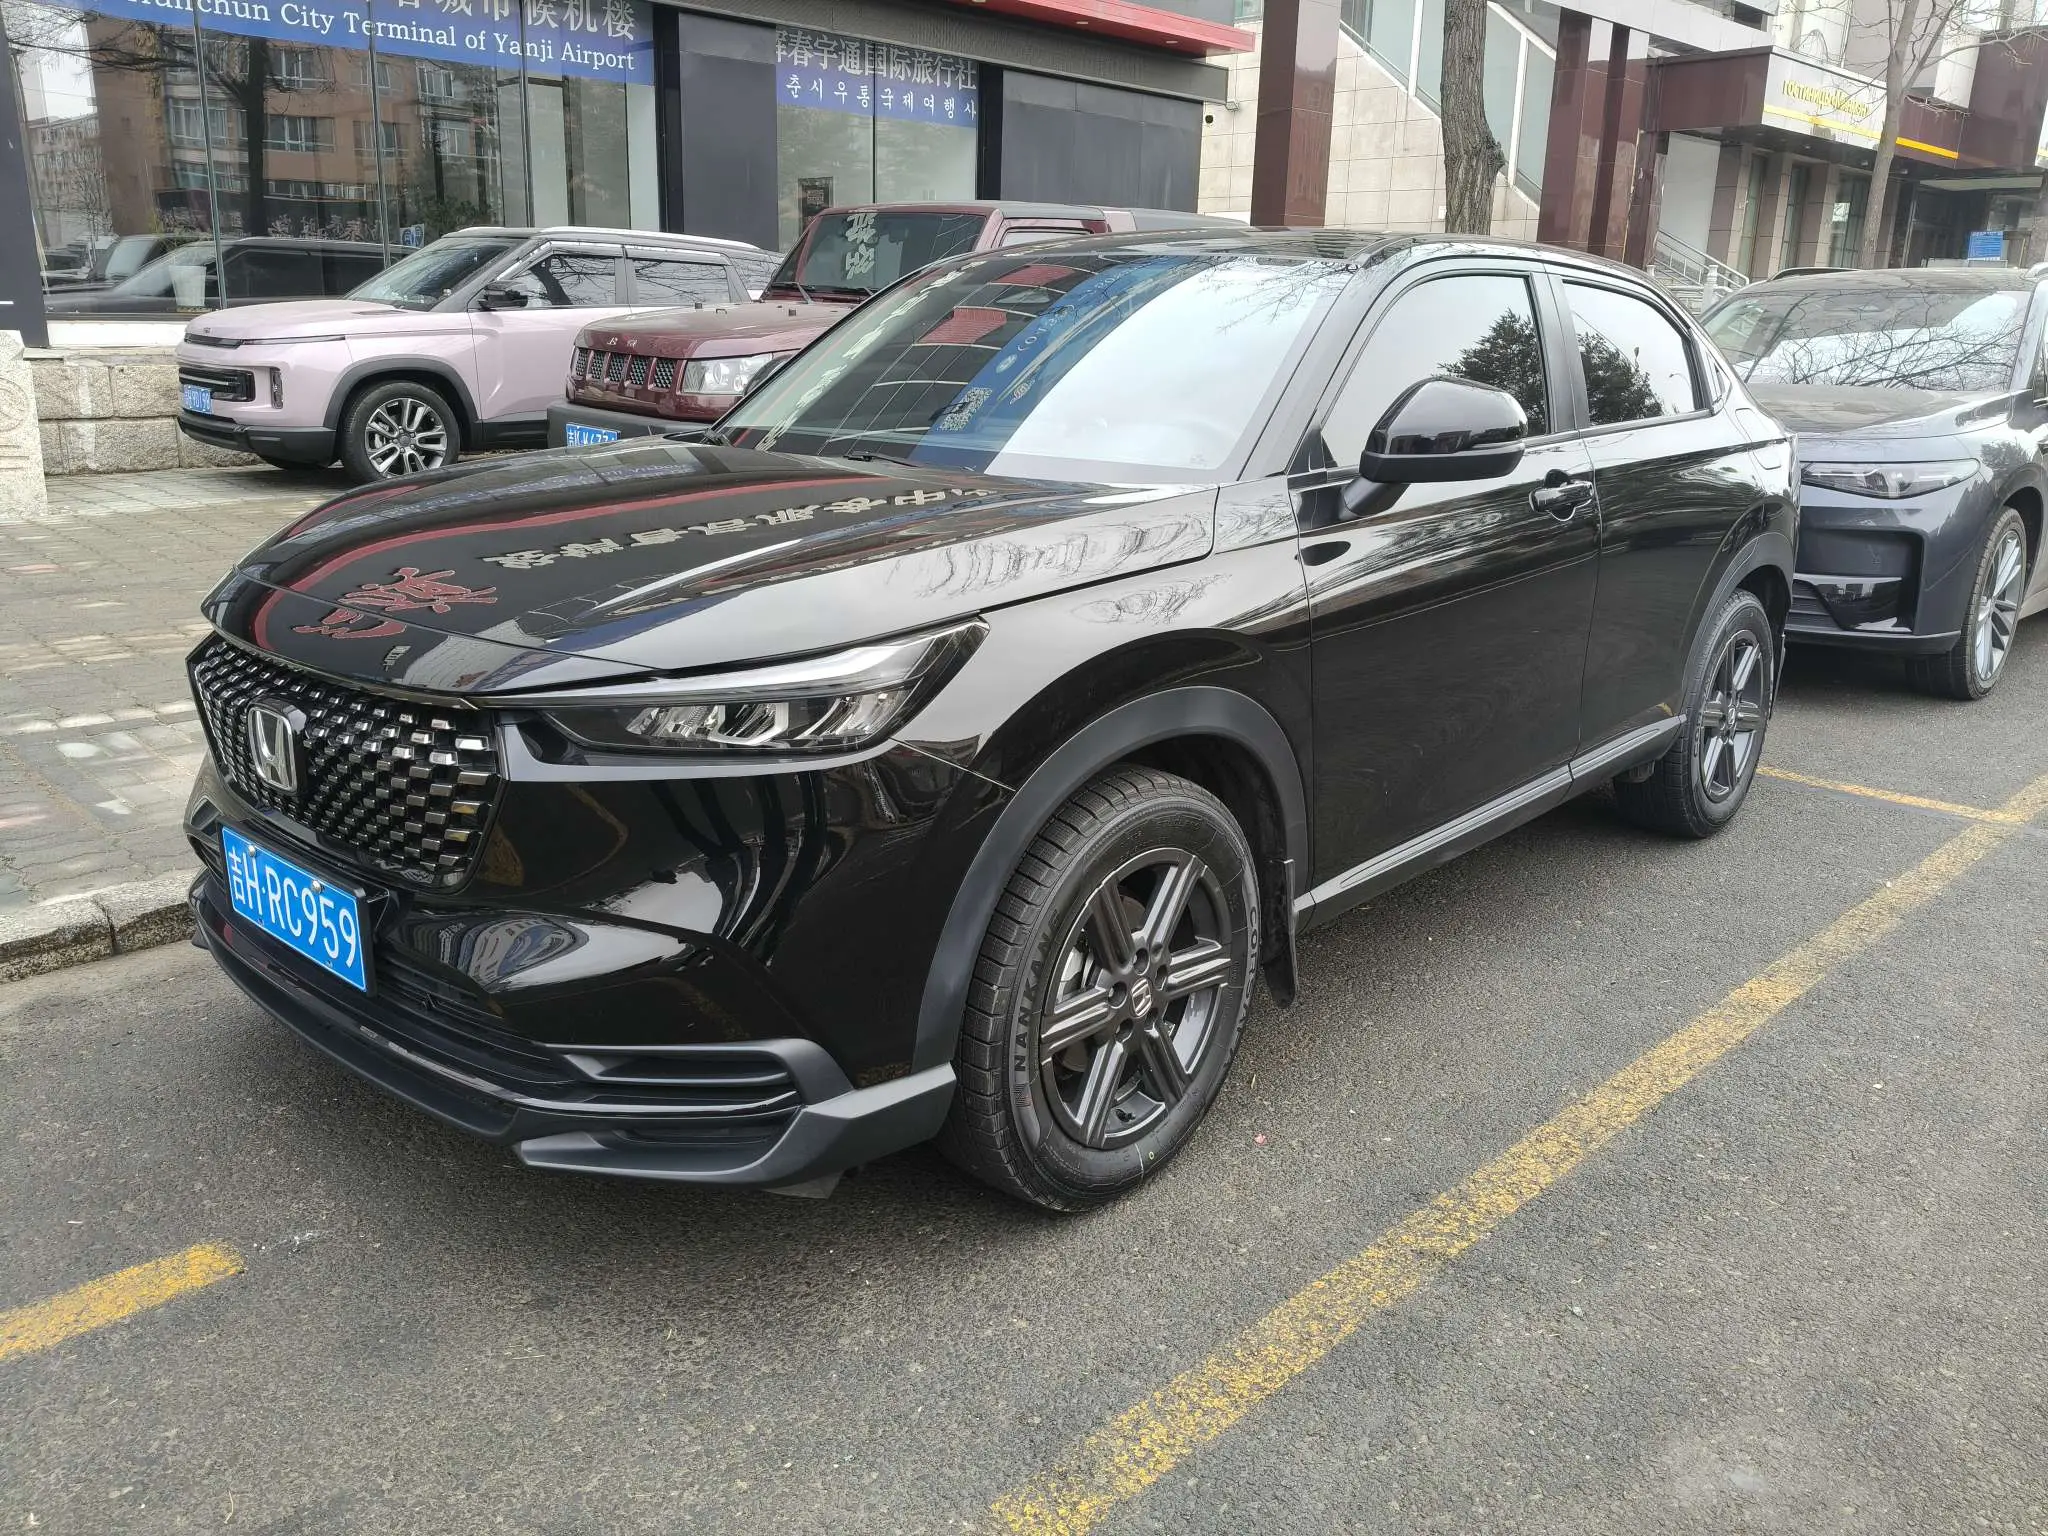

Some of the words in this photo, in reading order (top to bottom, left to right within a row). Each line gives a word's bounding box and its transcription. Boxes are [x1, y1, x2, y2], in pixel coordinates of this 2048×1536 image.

[128, 0, 271, 22] unchun
[281, 3, 335, 35] City
[343, 12, 457, 47] Terminal
[465, 30, 487, 51] of
[493, 32, 554, 63] Yanji
[561, 41, 635, 71] Airport
[228, 845, 357, 969] 吉H·RC959
